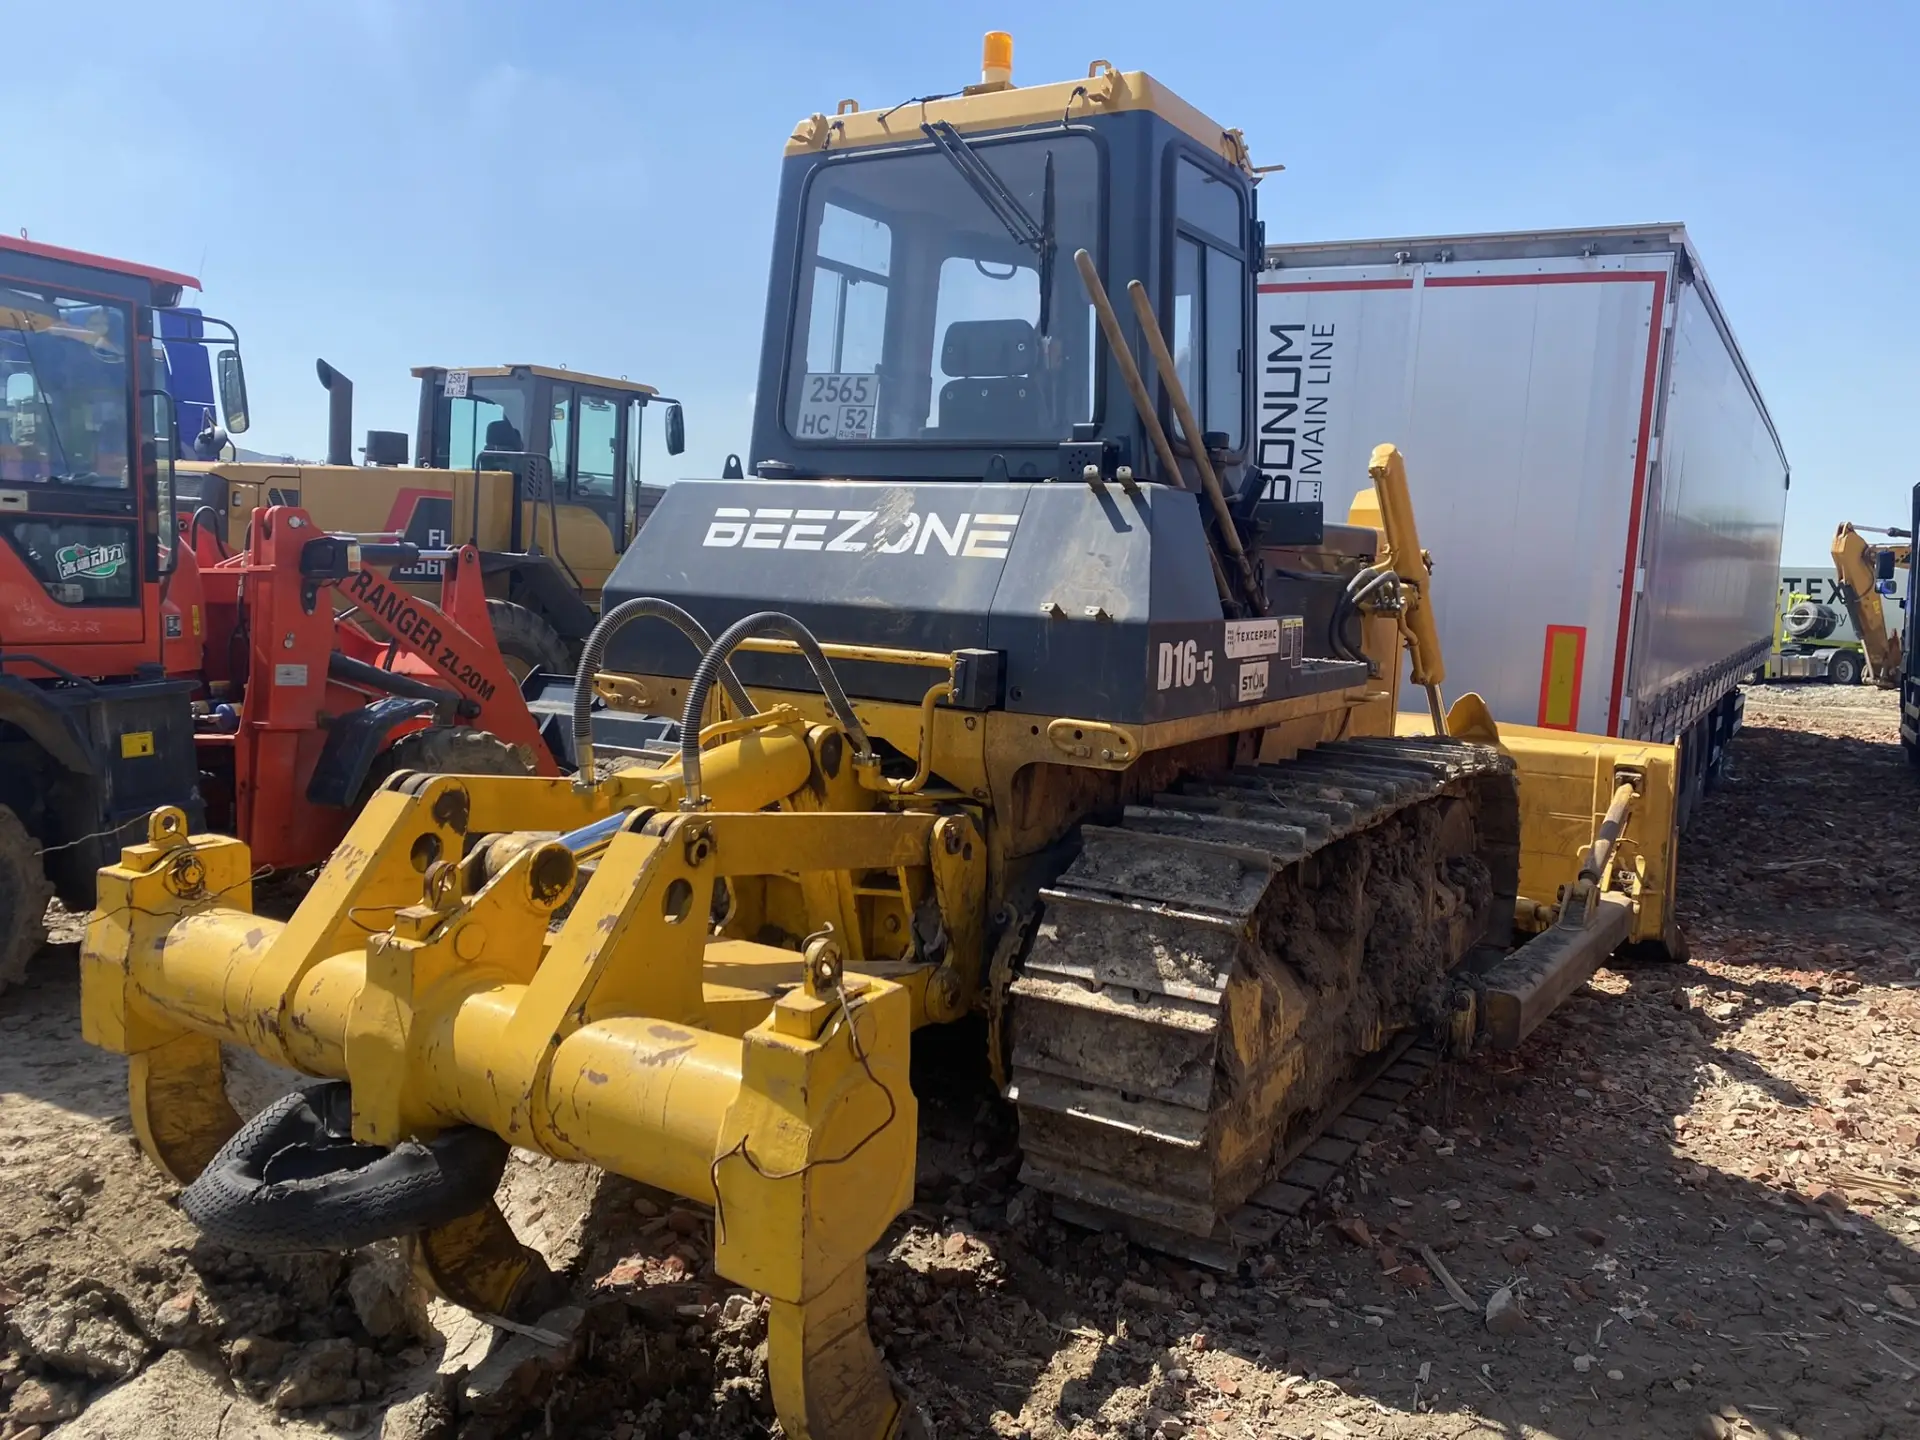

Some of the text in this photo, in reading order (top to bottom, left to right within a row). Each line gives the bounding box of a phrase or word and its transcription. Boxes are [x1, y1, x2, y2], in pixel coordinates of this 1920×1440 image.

[810, 377, 868, 403] 2565
[1258, 324, 1305, 502] BONUM
[1299, 323, 1334, 474] MAIN LINE
[802, 413, 831, 435] HC
[839, 430, 855, 438] RUS
[845, 408, 868, 429] 52
[702, 507, 1020, 559] BEEZONE
[351, 569, 496, 701] RANGER ZL20M
[1157, 639, 1213, 691] D16-5
